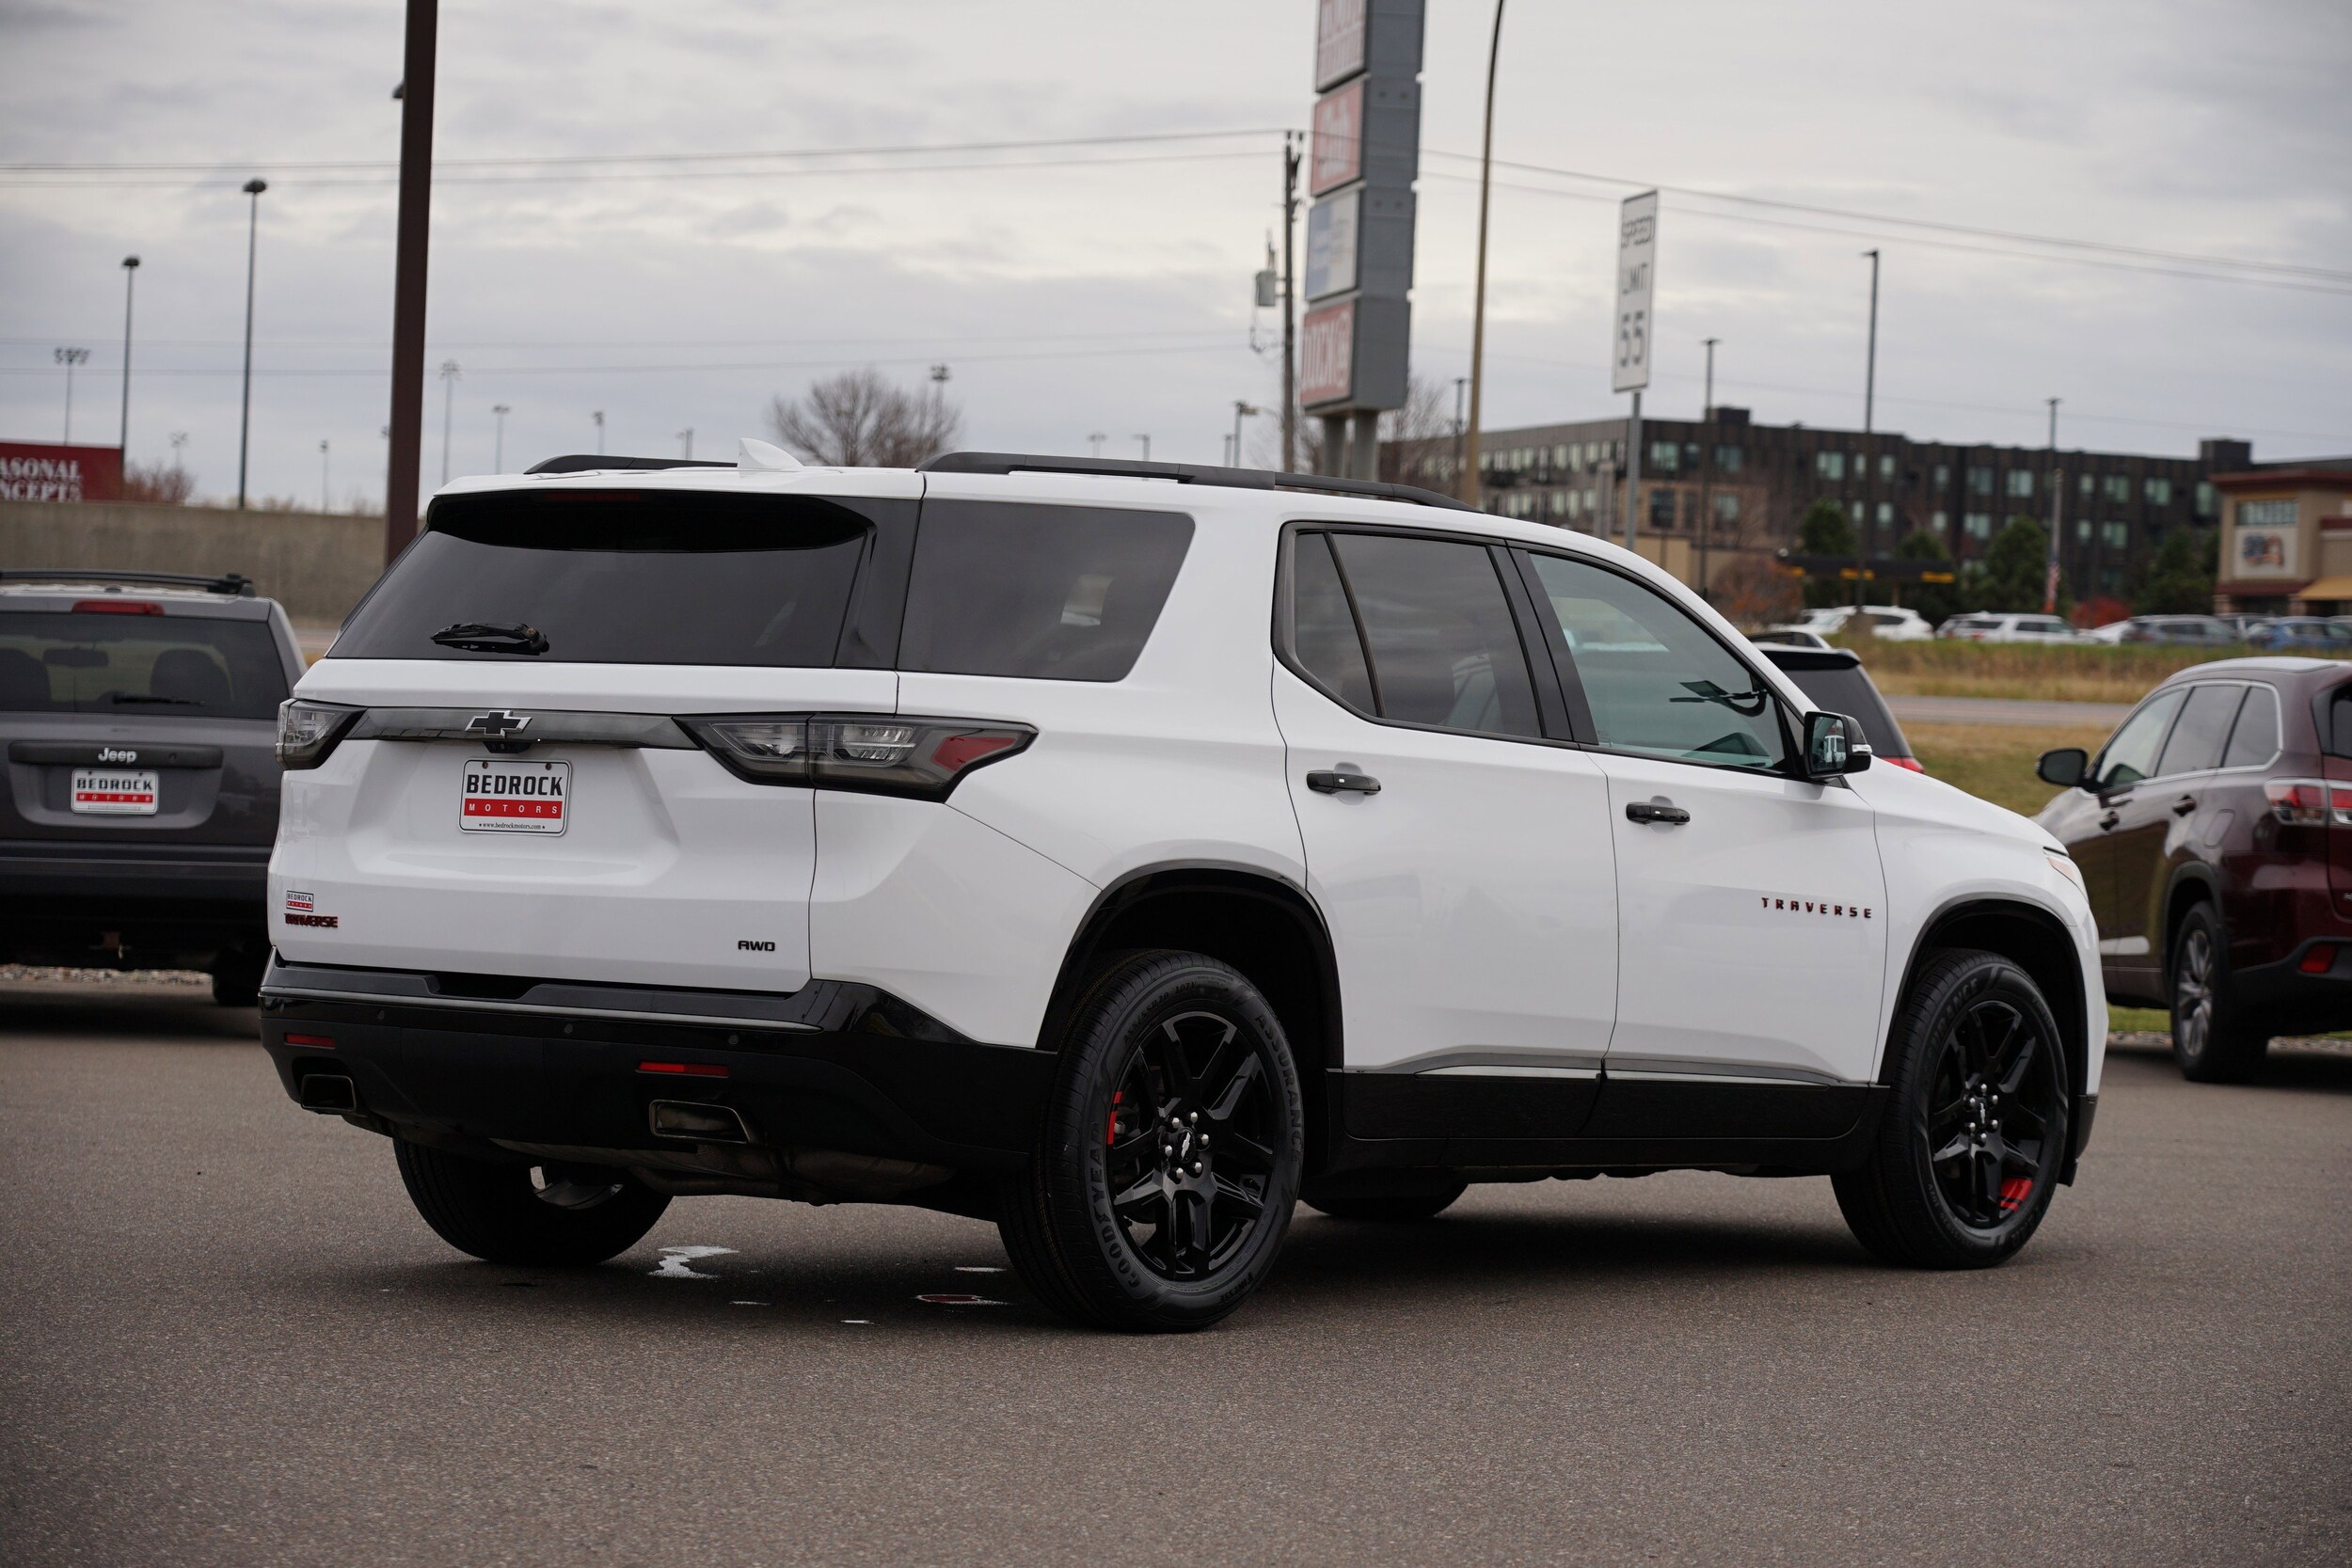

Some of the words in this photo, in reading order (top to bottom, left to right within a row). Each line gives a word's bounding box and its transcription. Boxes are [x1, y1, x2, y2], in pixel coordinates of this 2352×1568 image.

[1620, 310, 1645, 367] 55
[98, 748, 136, 764] Jeep
[77, 779, 152, 790] BEDROCK
[467, 774, 563, 796] BEDROCK
[469, 803, 558, 814] MOTORS
[287, 893, 312, 902] BEDROCK
[1761, 897, 1872, 919] TRAVERSE
[738, 940, 776, 952] AWD
